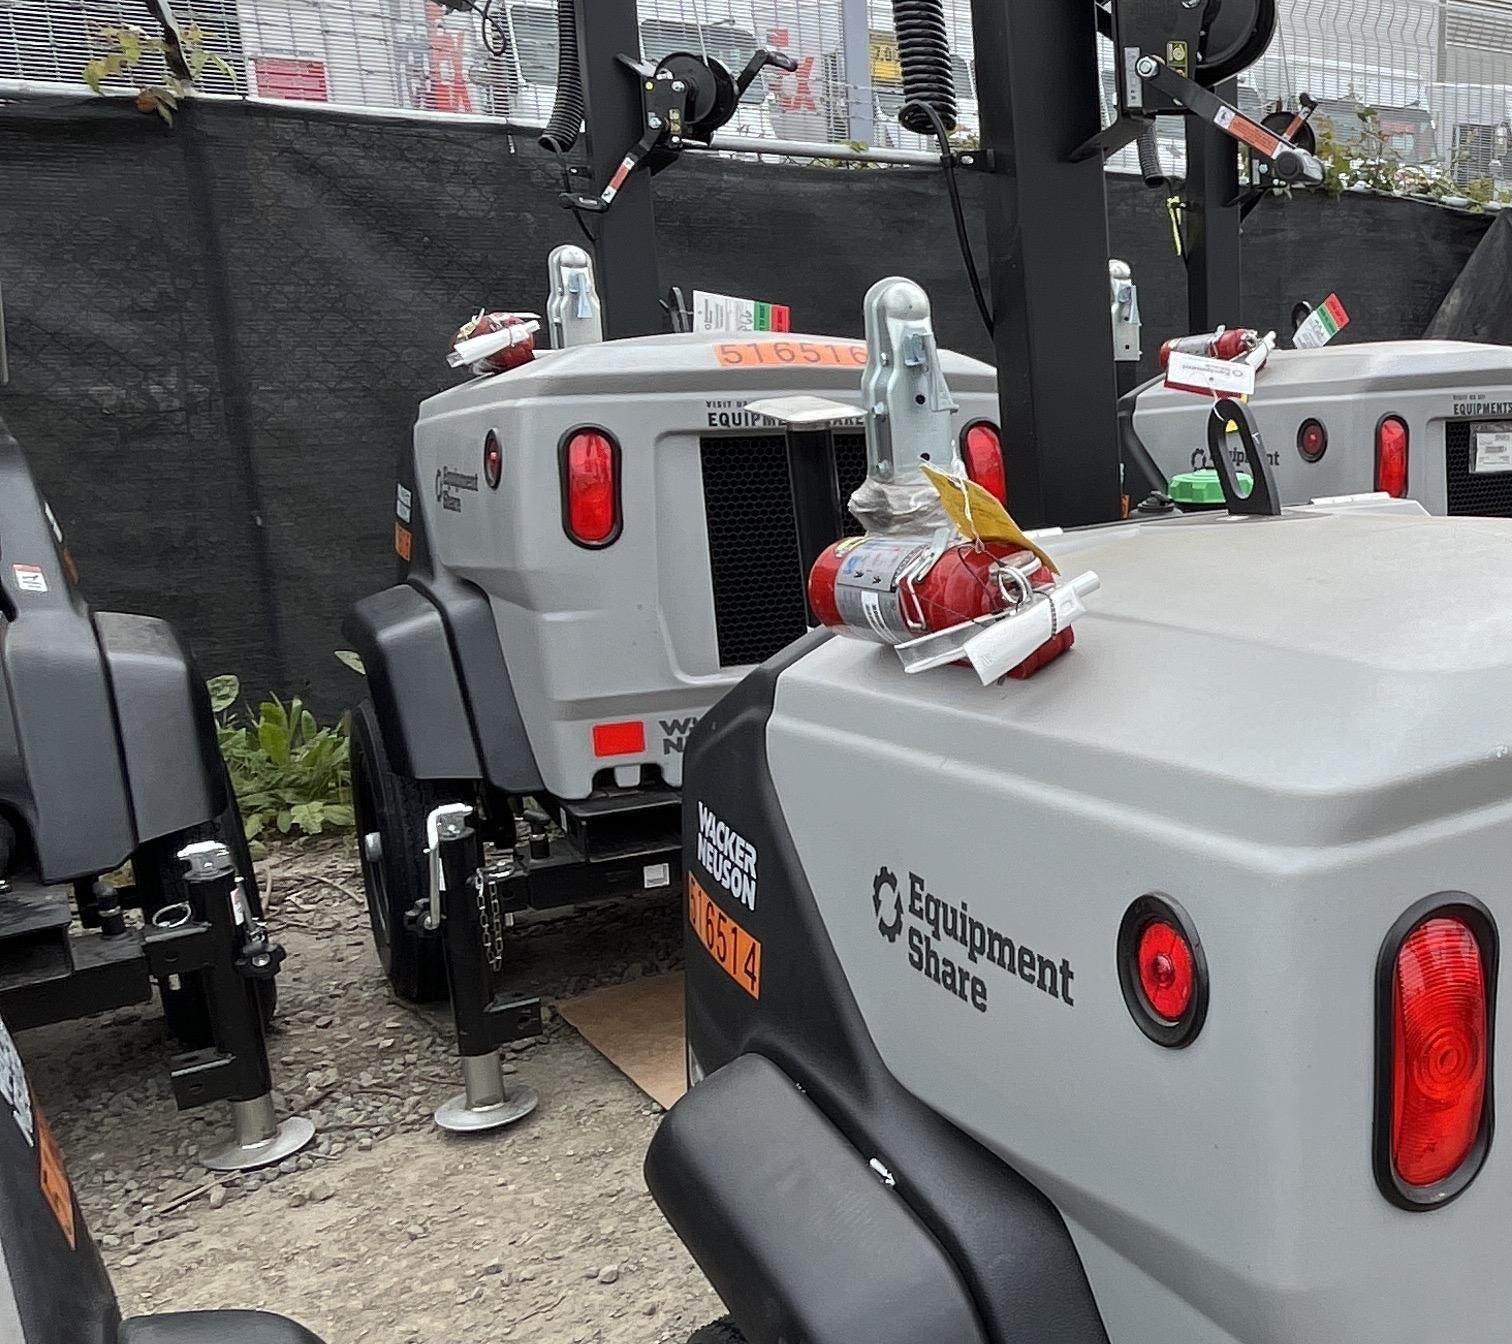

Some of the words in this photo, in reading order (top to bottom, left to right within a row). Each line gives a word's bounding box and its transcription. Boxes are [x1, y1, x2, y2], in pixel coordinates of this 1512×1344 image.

[697, 832, 757, 911] NEUSON
[698, 801, 757, 879] WACKER
[690, 882, 757, 992] 516514
[908, 926, 987, 1013] Share
[909, 871, 1074, 1006] Equipment
